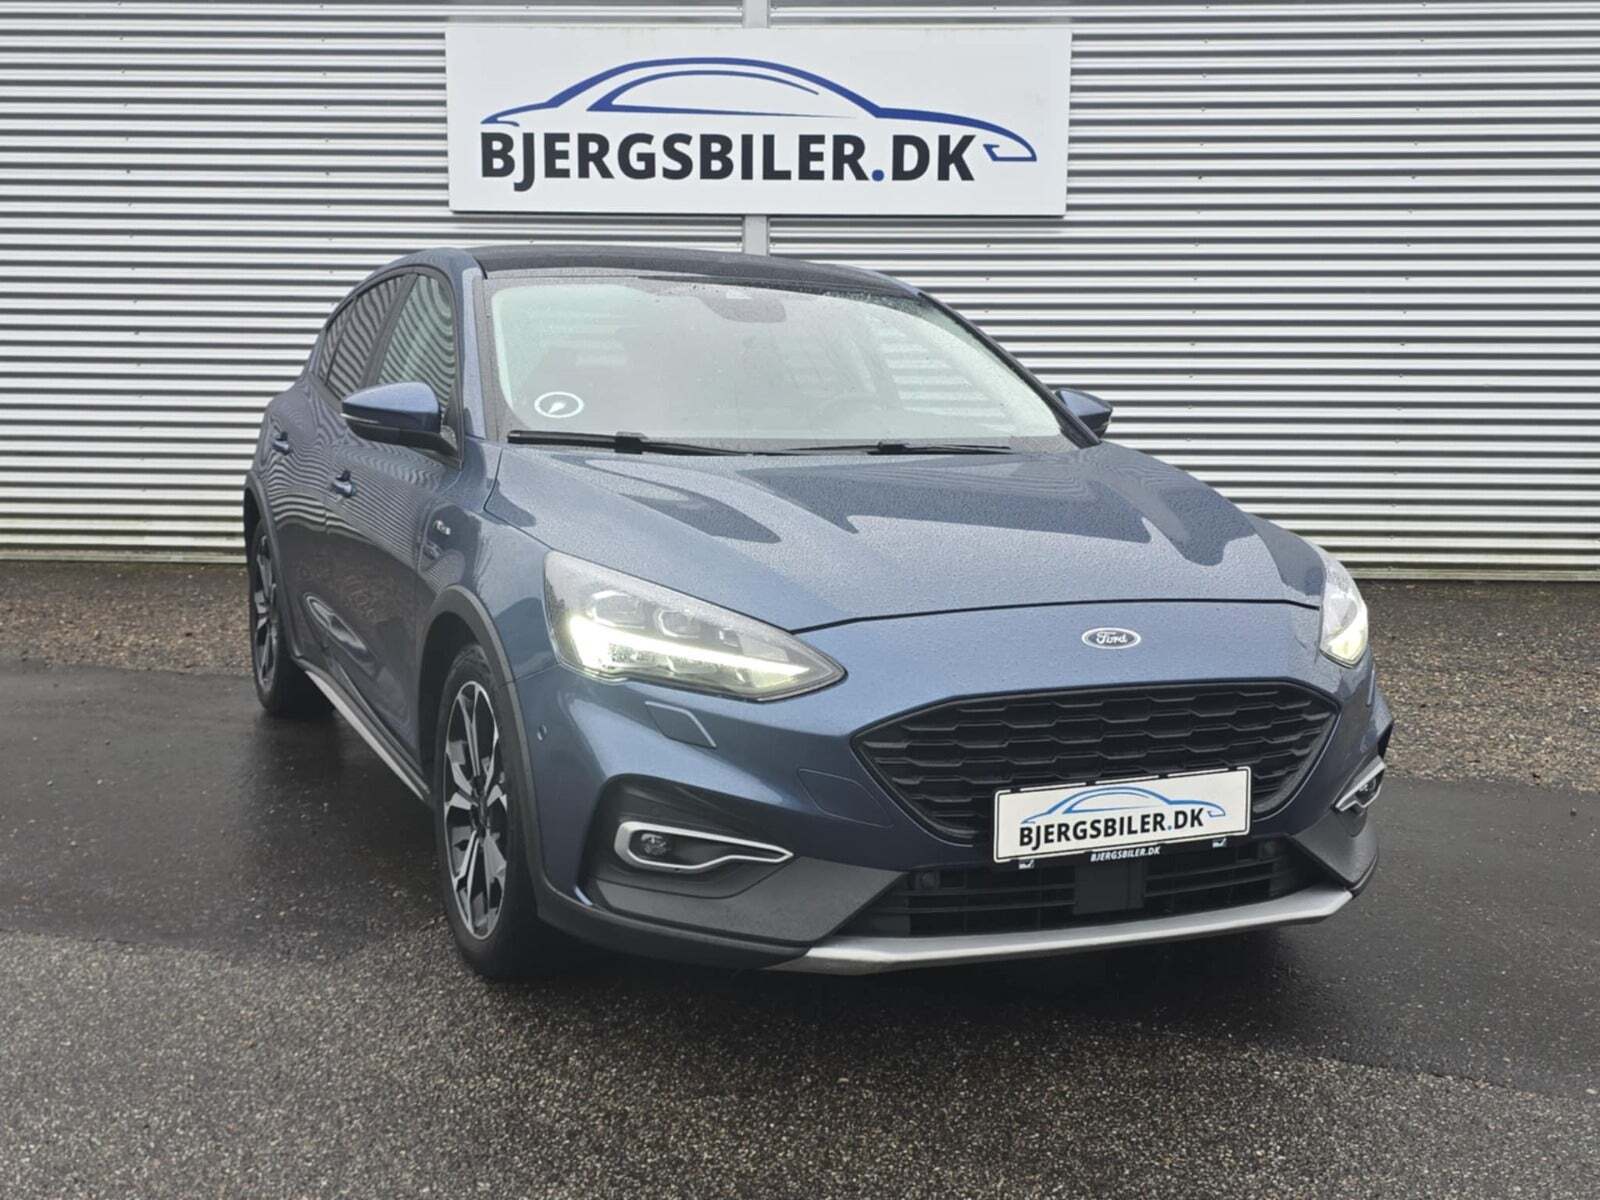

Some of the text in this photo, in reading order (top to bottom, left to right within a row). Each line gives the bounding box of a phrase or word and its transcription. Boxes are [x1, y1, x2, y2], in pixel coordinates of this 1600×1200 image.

[480, 131, 976, 192] BJERGSBILER.DK
[1096, 631, 1128, 644] Ford
[1019, 807, 1204, 850] BJERGSBILER.DK
[1090, 846, 1161, 862] BJERGSBILER.DK
